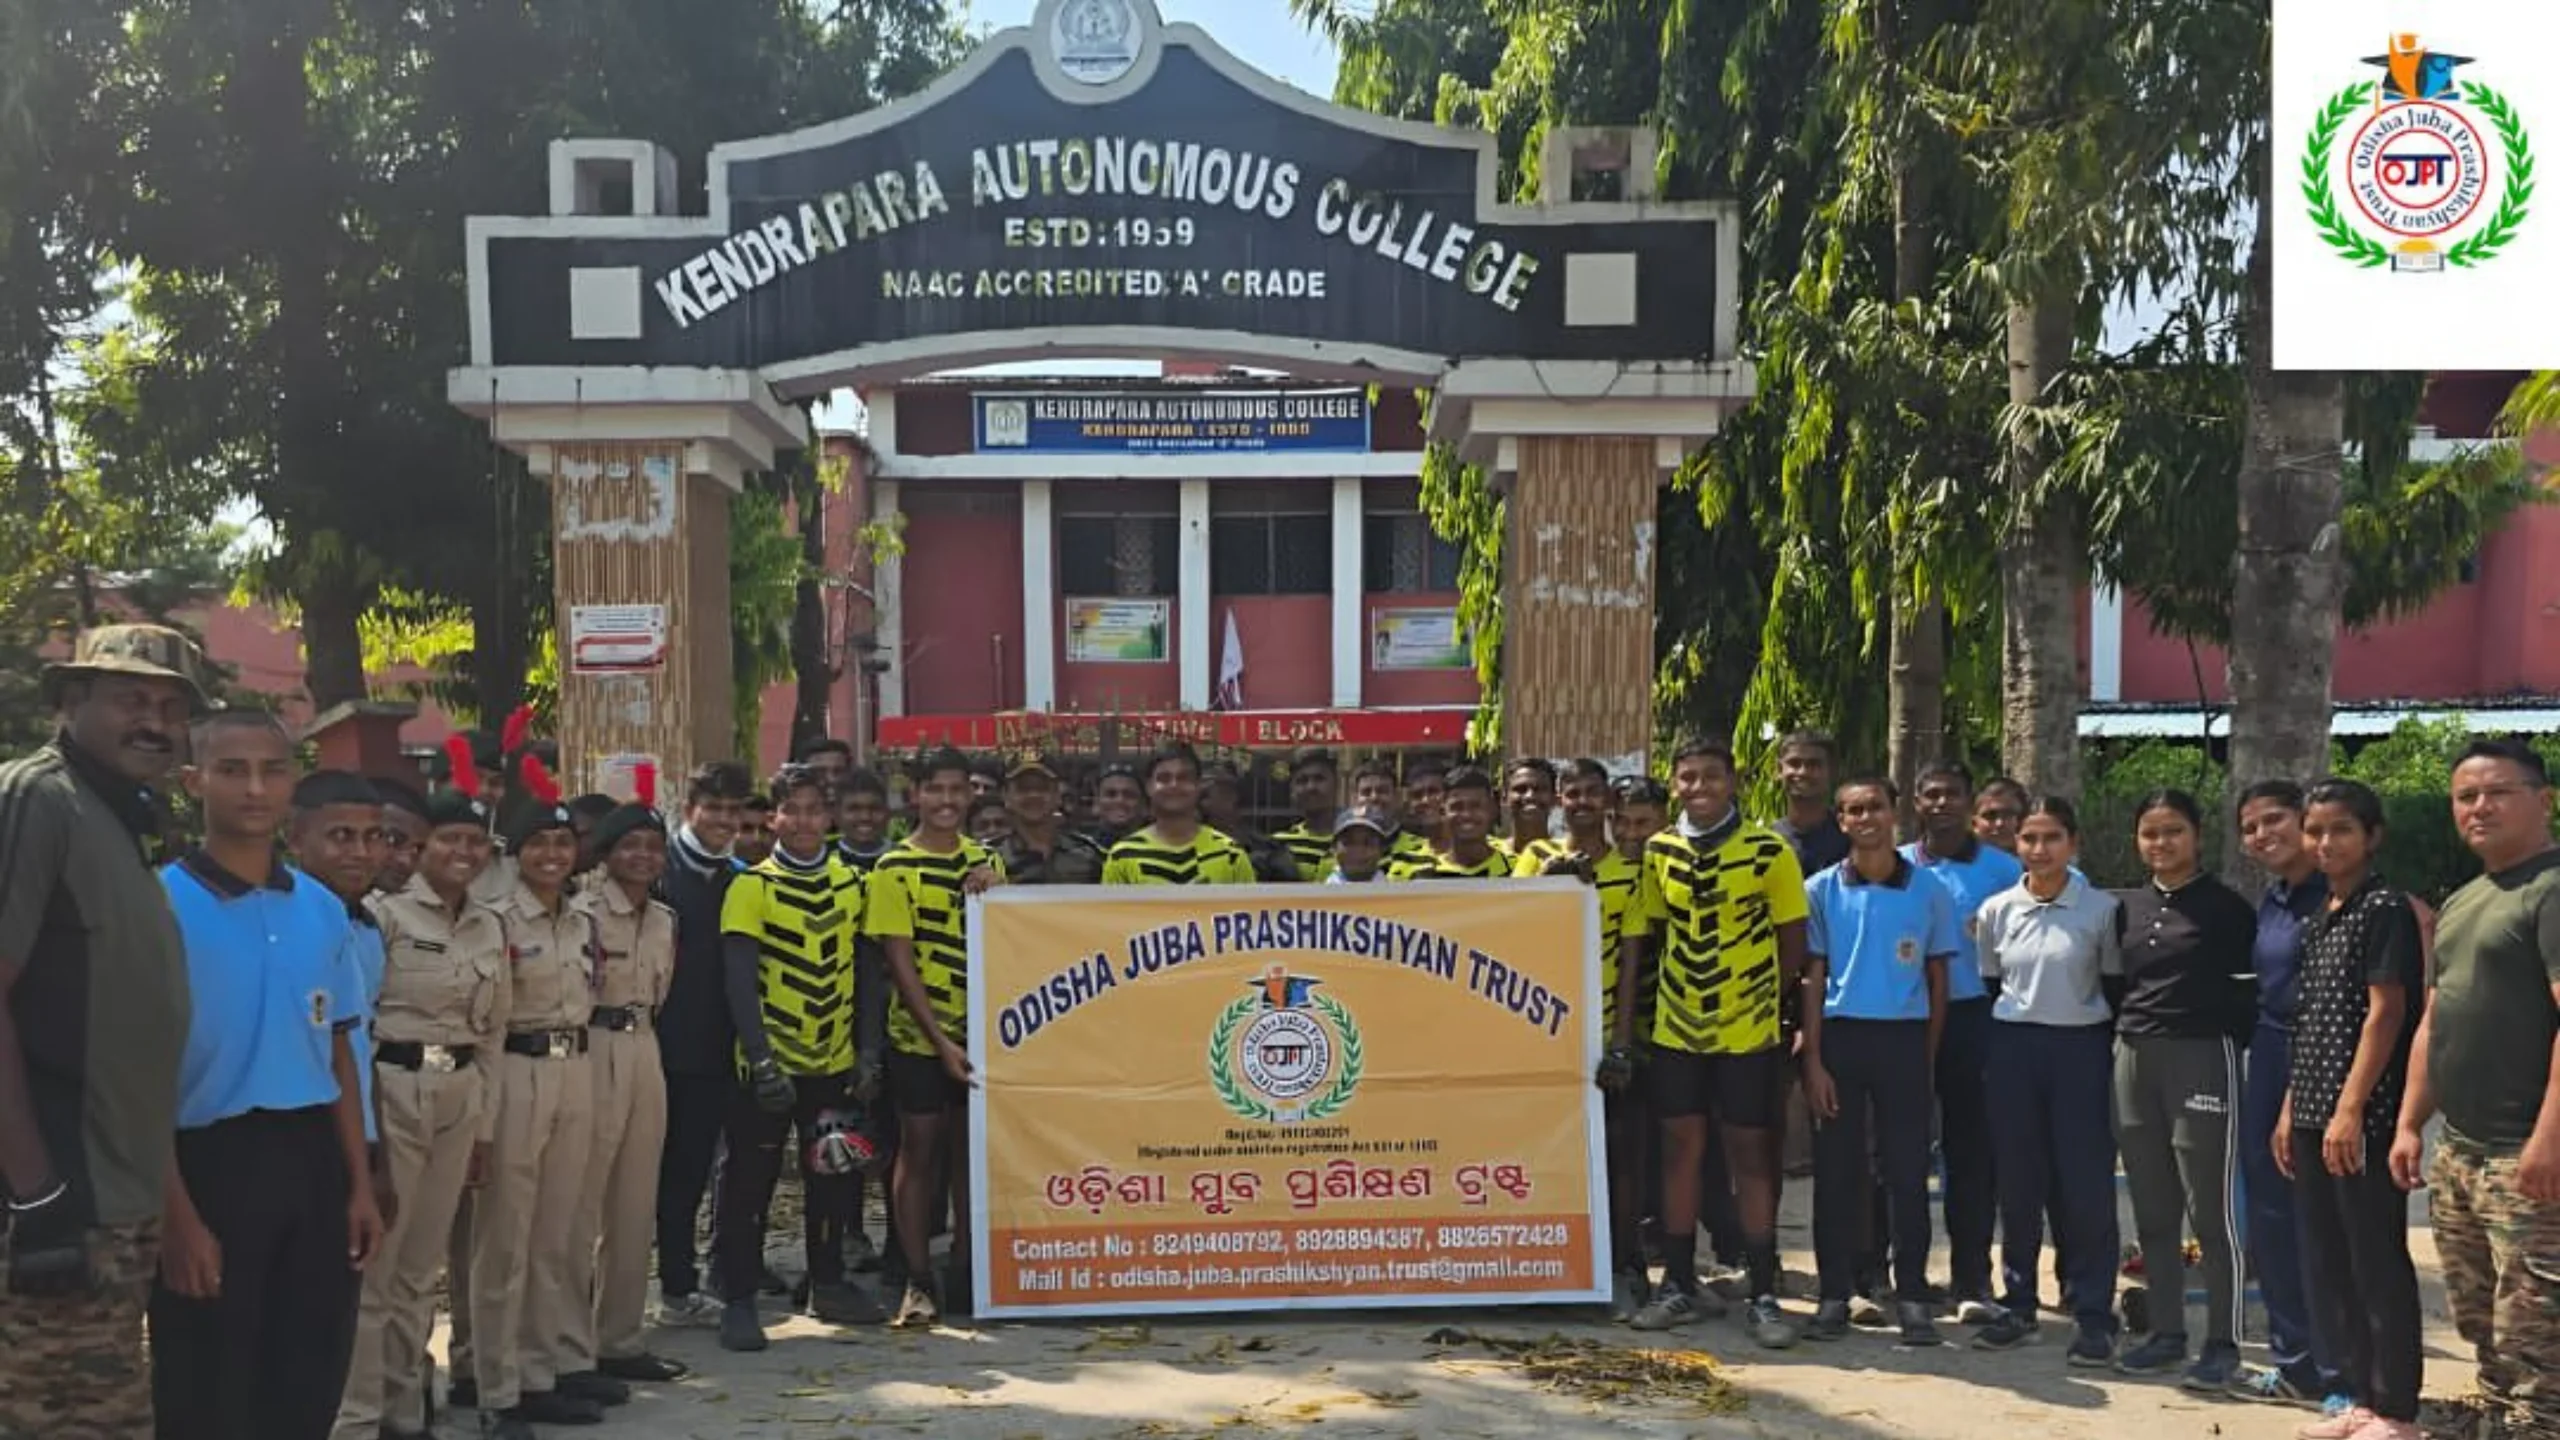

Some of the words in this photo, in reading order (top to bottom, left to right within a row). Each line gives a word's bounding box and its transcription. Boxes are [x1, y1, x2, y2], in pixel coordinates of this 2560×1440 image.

[654, 160, 949, 328] KENDRAPARA
[972, 136, 1300, 220] AUTONOMOUS
[1315, 174, 1540, 312] COLLEGE
[882, 269, 963, 298] NAAC
[1221, 270, 1326, 298] GRADE
[999, 952, 1116, 1048] ODISHA
[1124, 921, 1205, 980] JUBA
[1213, 909, 1458, 981] PRASHIKSHYAN
[1469, 949, 1569, 1037] TRUST
[1048, 1166, 1165, 1215] ଓଡ଼ିଶା
[1192, 1172, 1261, 1215] ଯୁବ
[1286, 1159, 1430, 1208] ପ୍ରଶିକ୍ଷଣ
[1014, 1237, 1098, 1260] Contact
[1104, 1234, 1133, 1256] No
